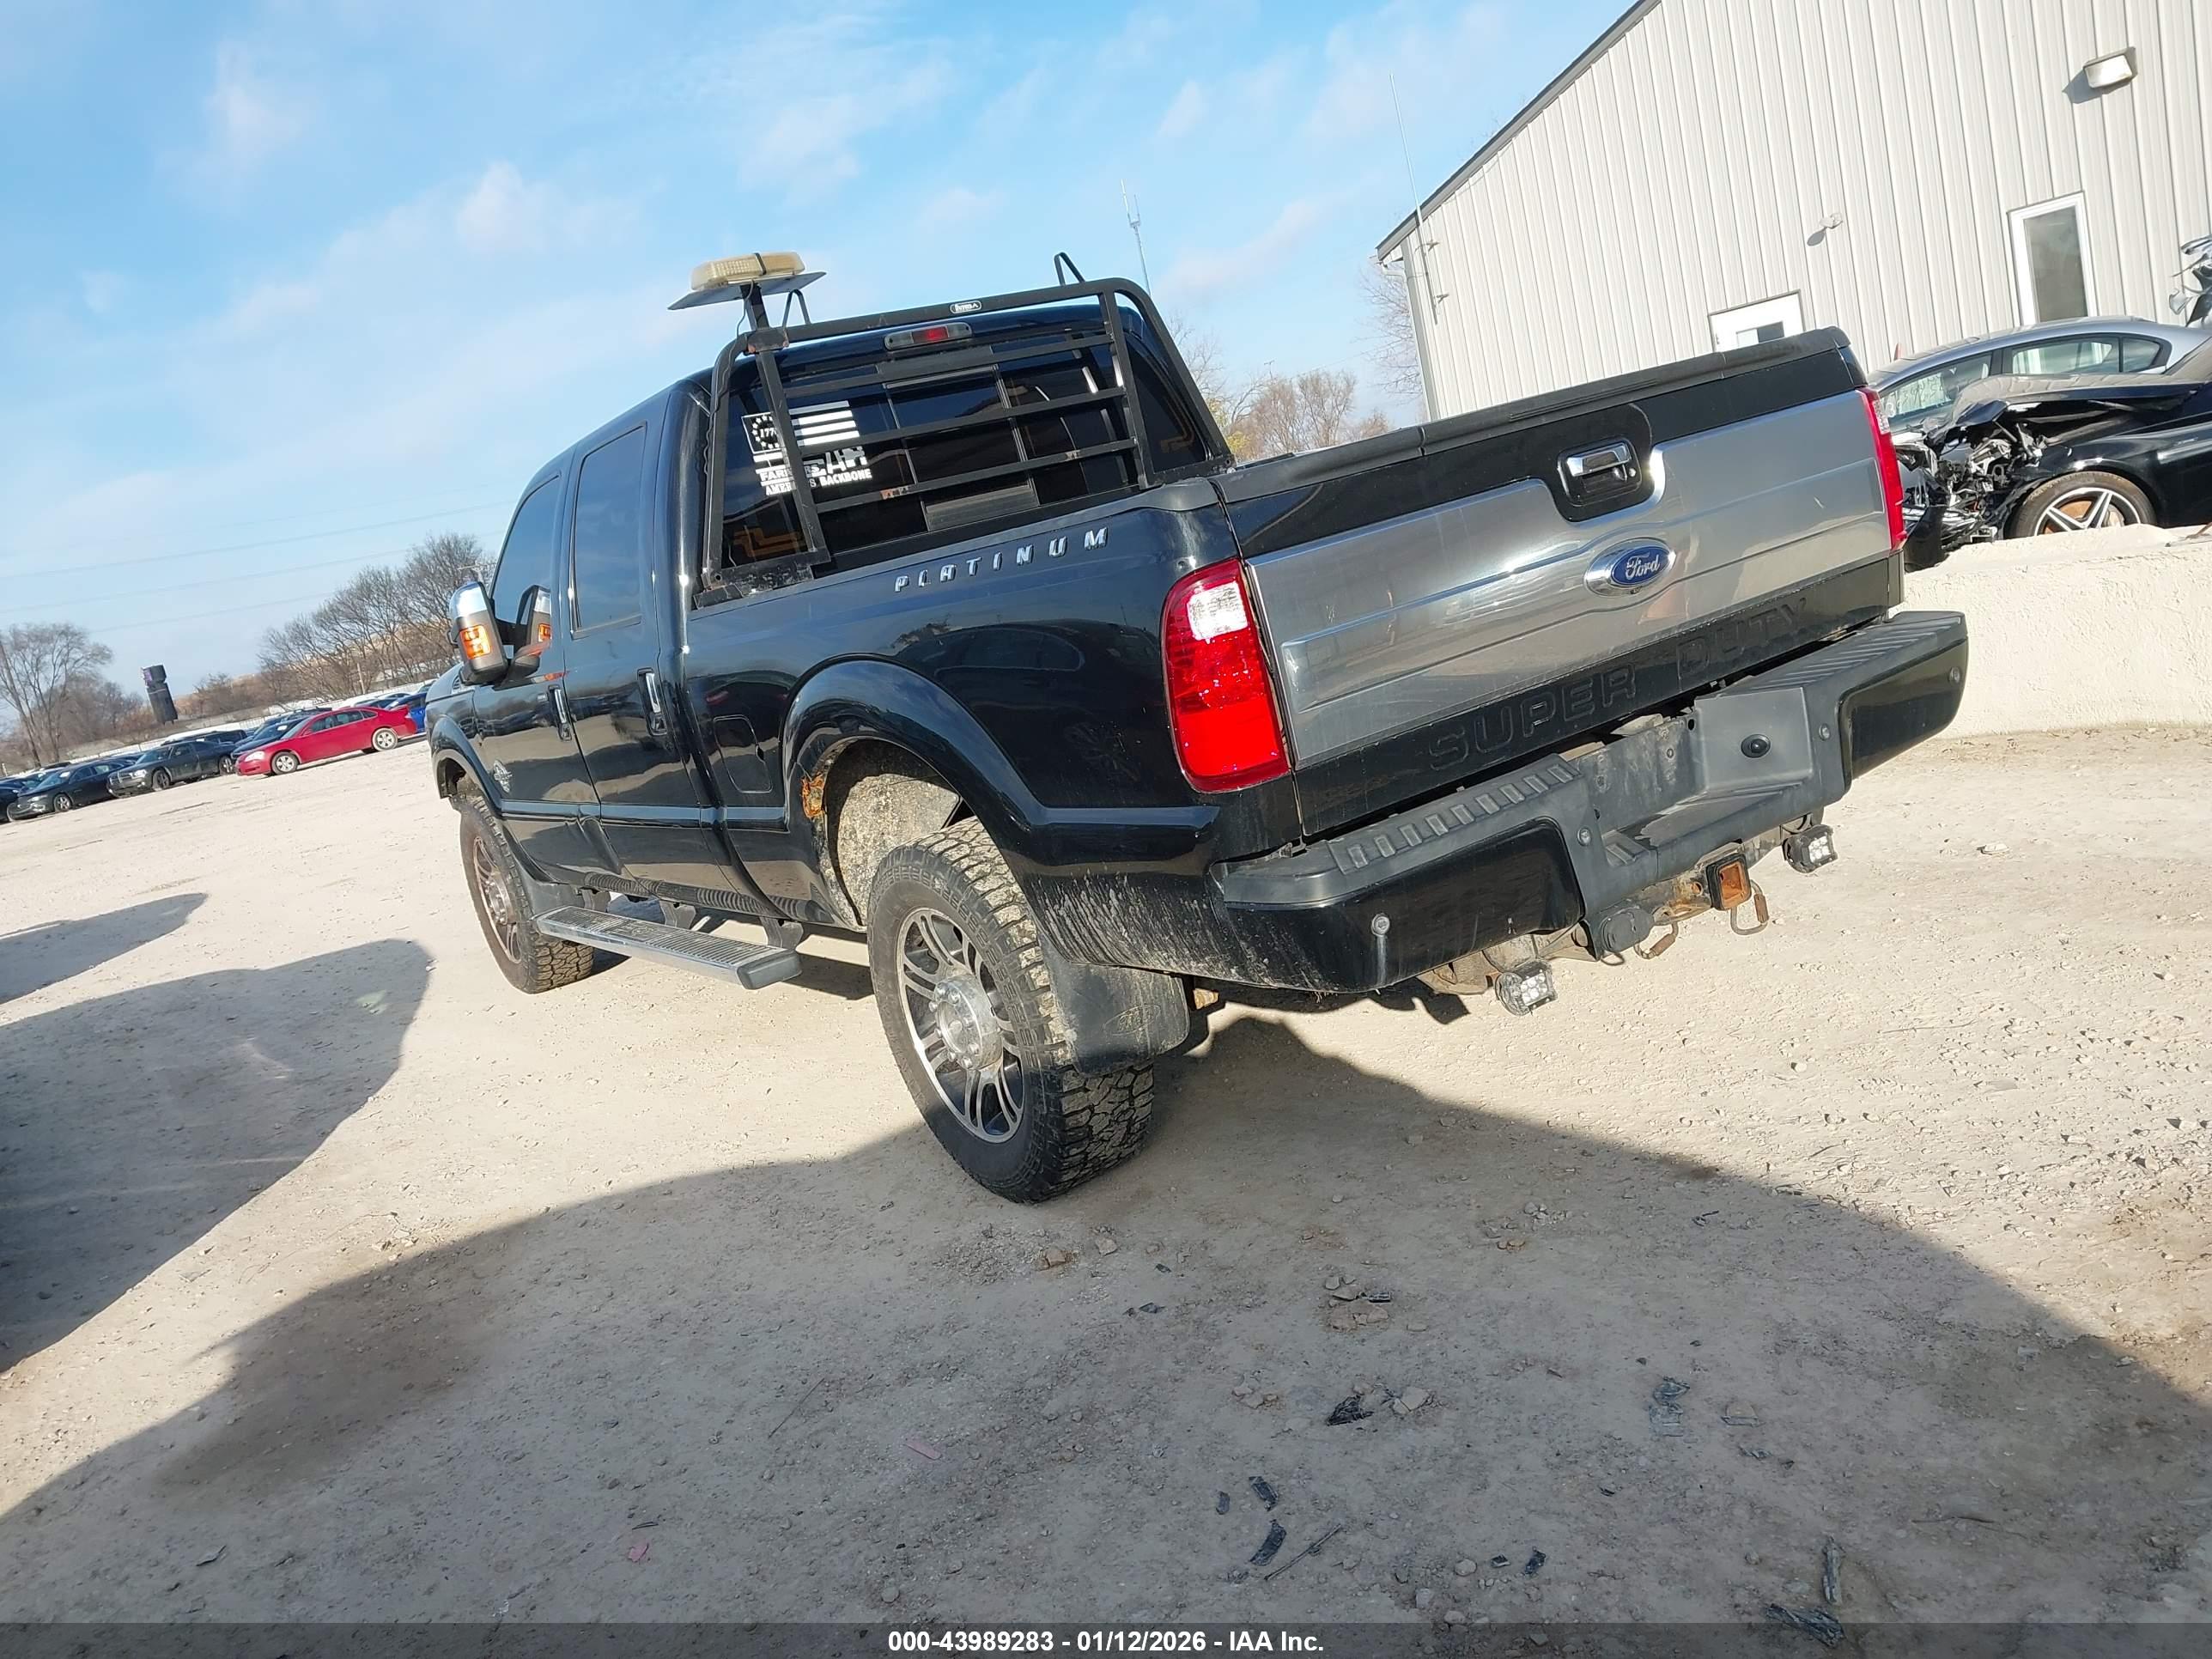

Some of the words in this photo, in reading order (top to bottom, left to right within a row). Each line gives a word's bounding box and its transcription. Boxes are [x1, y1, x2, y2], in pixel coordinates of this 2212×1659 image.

[819, 468, 872, 487] BACKBONE
[895, 526, 1108, 592] PLATINUM
[1625, 551, 1661, 580] Ford
[1428, 664, 1638, 770] SUPER
[1676, 596, 1808, 674] DUTY
